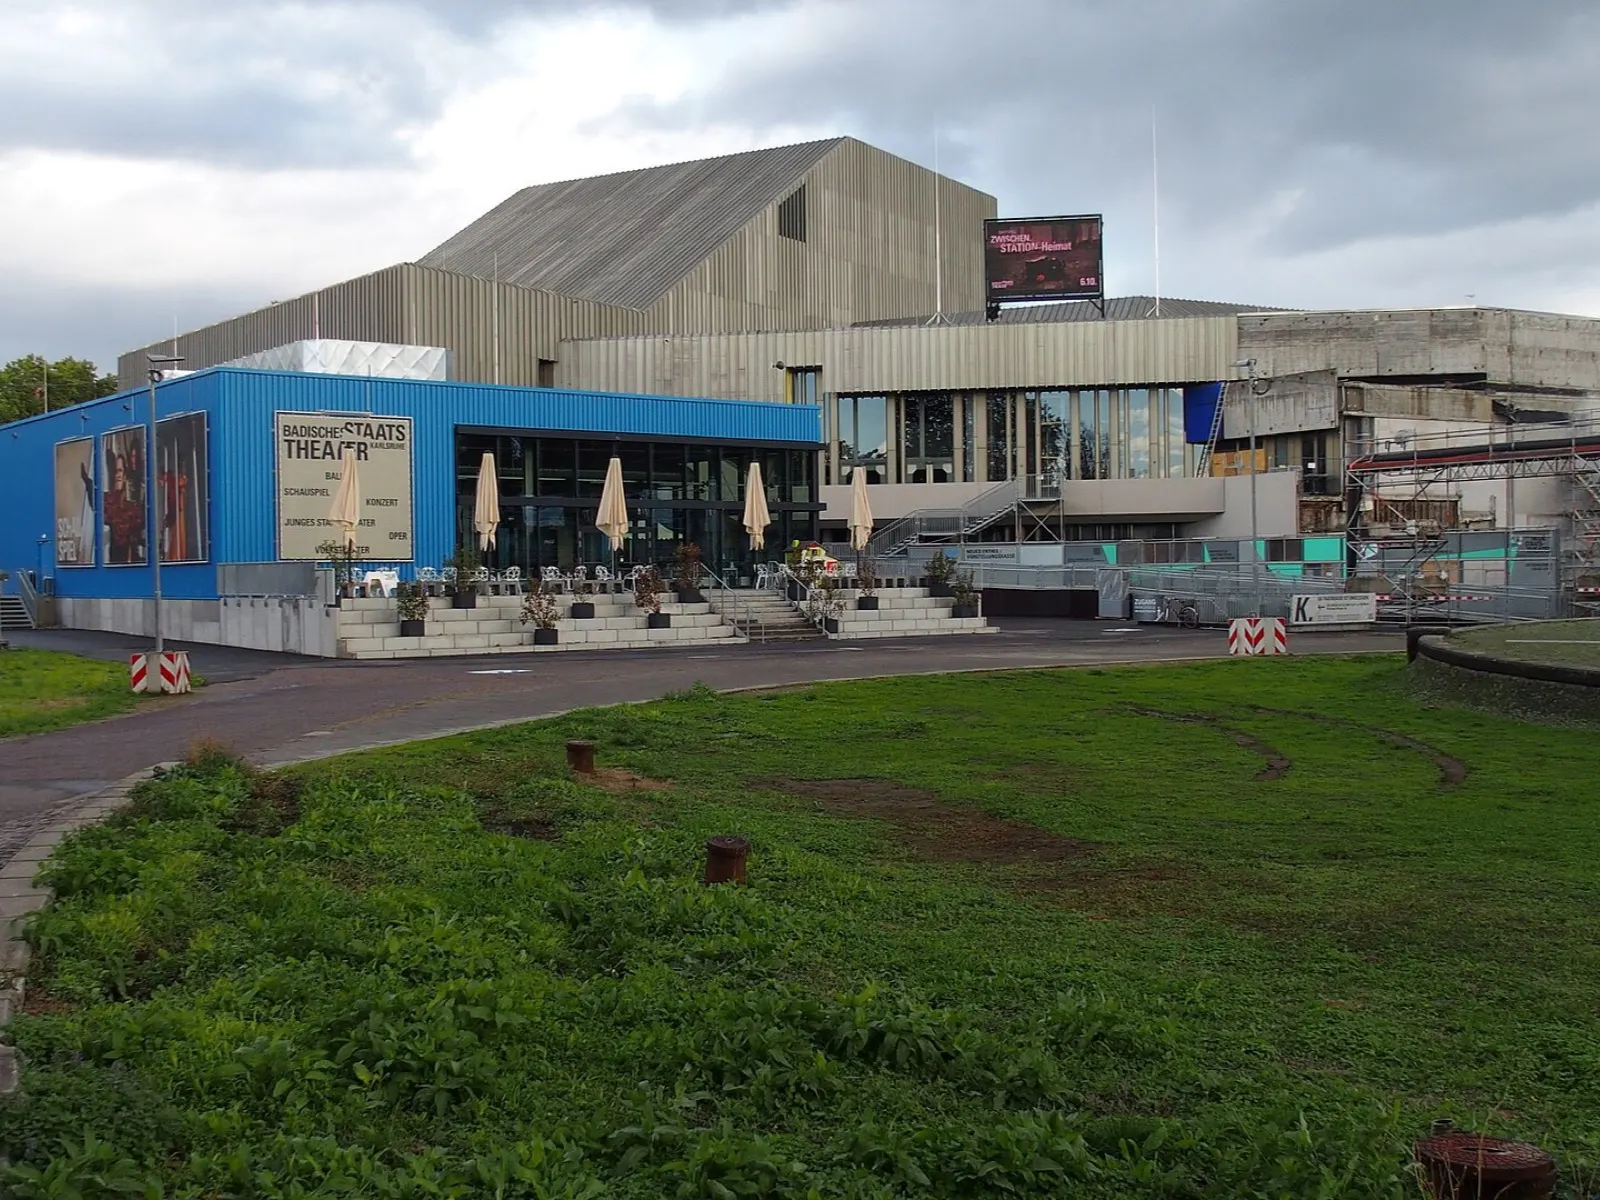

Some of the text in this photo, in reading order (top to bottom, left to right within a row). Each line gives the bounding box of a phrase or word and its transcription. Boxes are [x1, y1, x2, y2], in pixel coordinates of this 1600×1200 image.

[344, 421, 406, 442] STAATS
[370, 442, 406, 451] KARLSRUHE
[283, 487, 331, 497] SCHAUSPIEL
[365, 498, 399, 507] KONZERT
[284, 518, 316, 527] JUNGES
[388, 531, 408, 541] OPER
